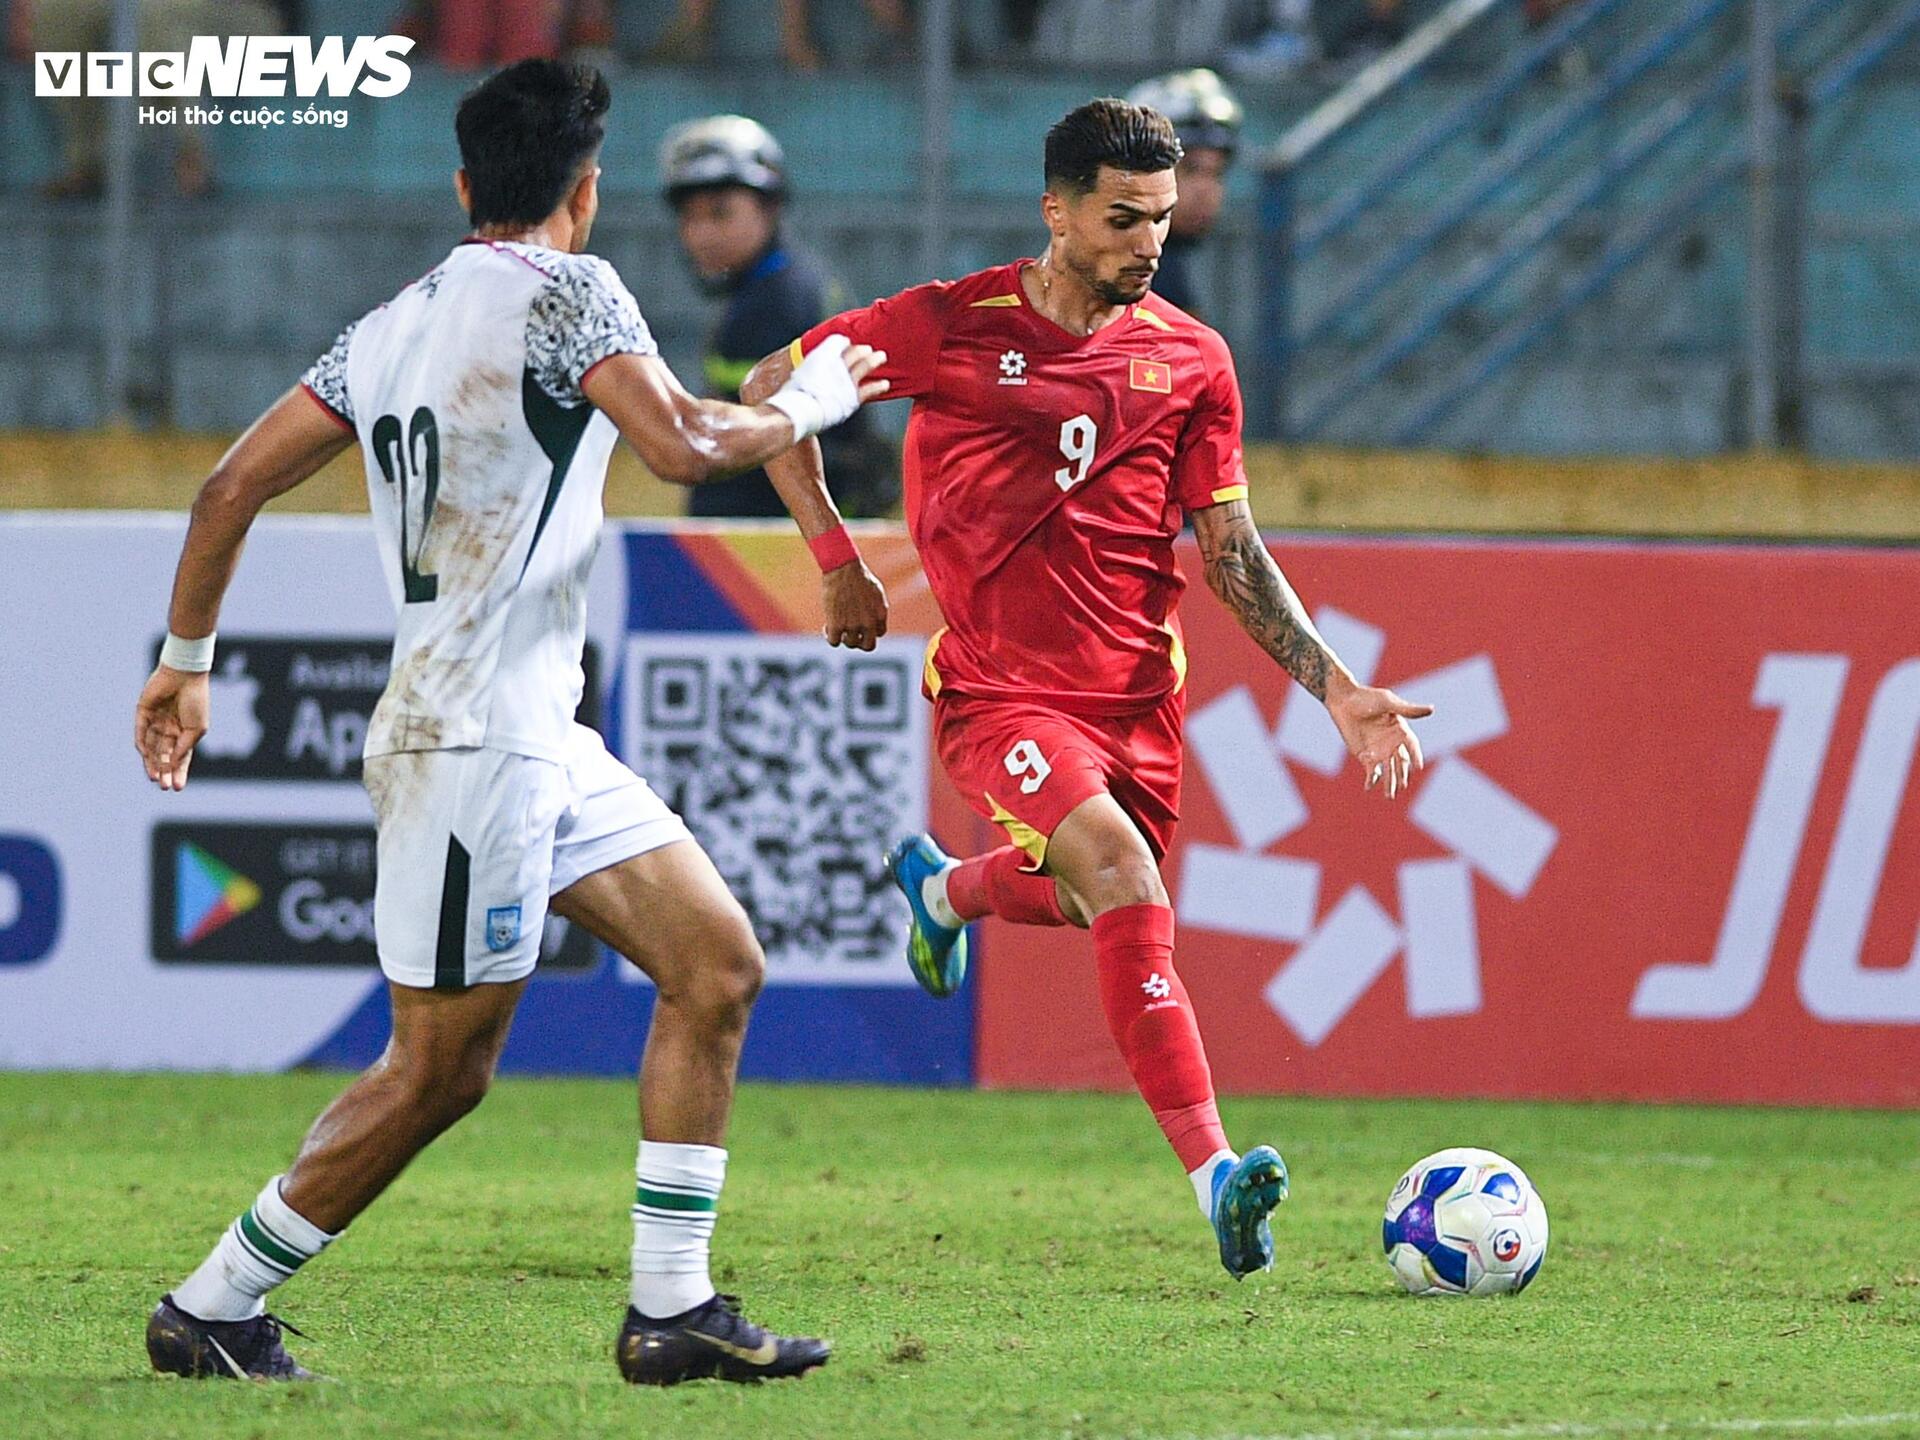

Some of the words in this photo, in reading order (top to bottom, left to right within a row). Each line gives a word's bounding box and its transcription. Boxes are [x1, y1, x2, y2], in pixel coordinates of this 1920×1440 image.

[1055, 414, 1098, 492] 9
[288, 698, 368, 770] Ap
[1003, 739, 1052, 795] 9
[280, 880, 376, 941] Goo
